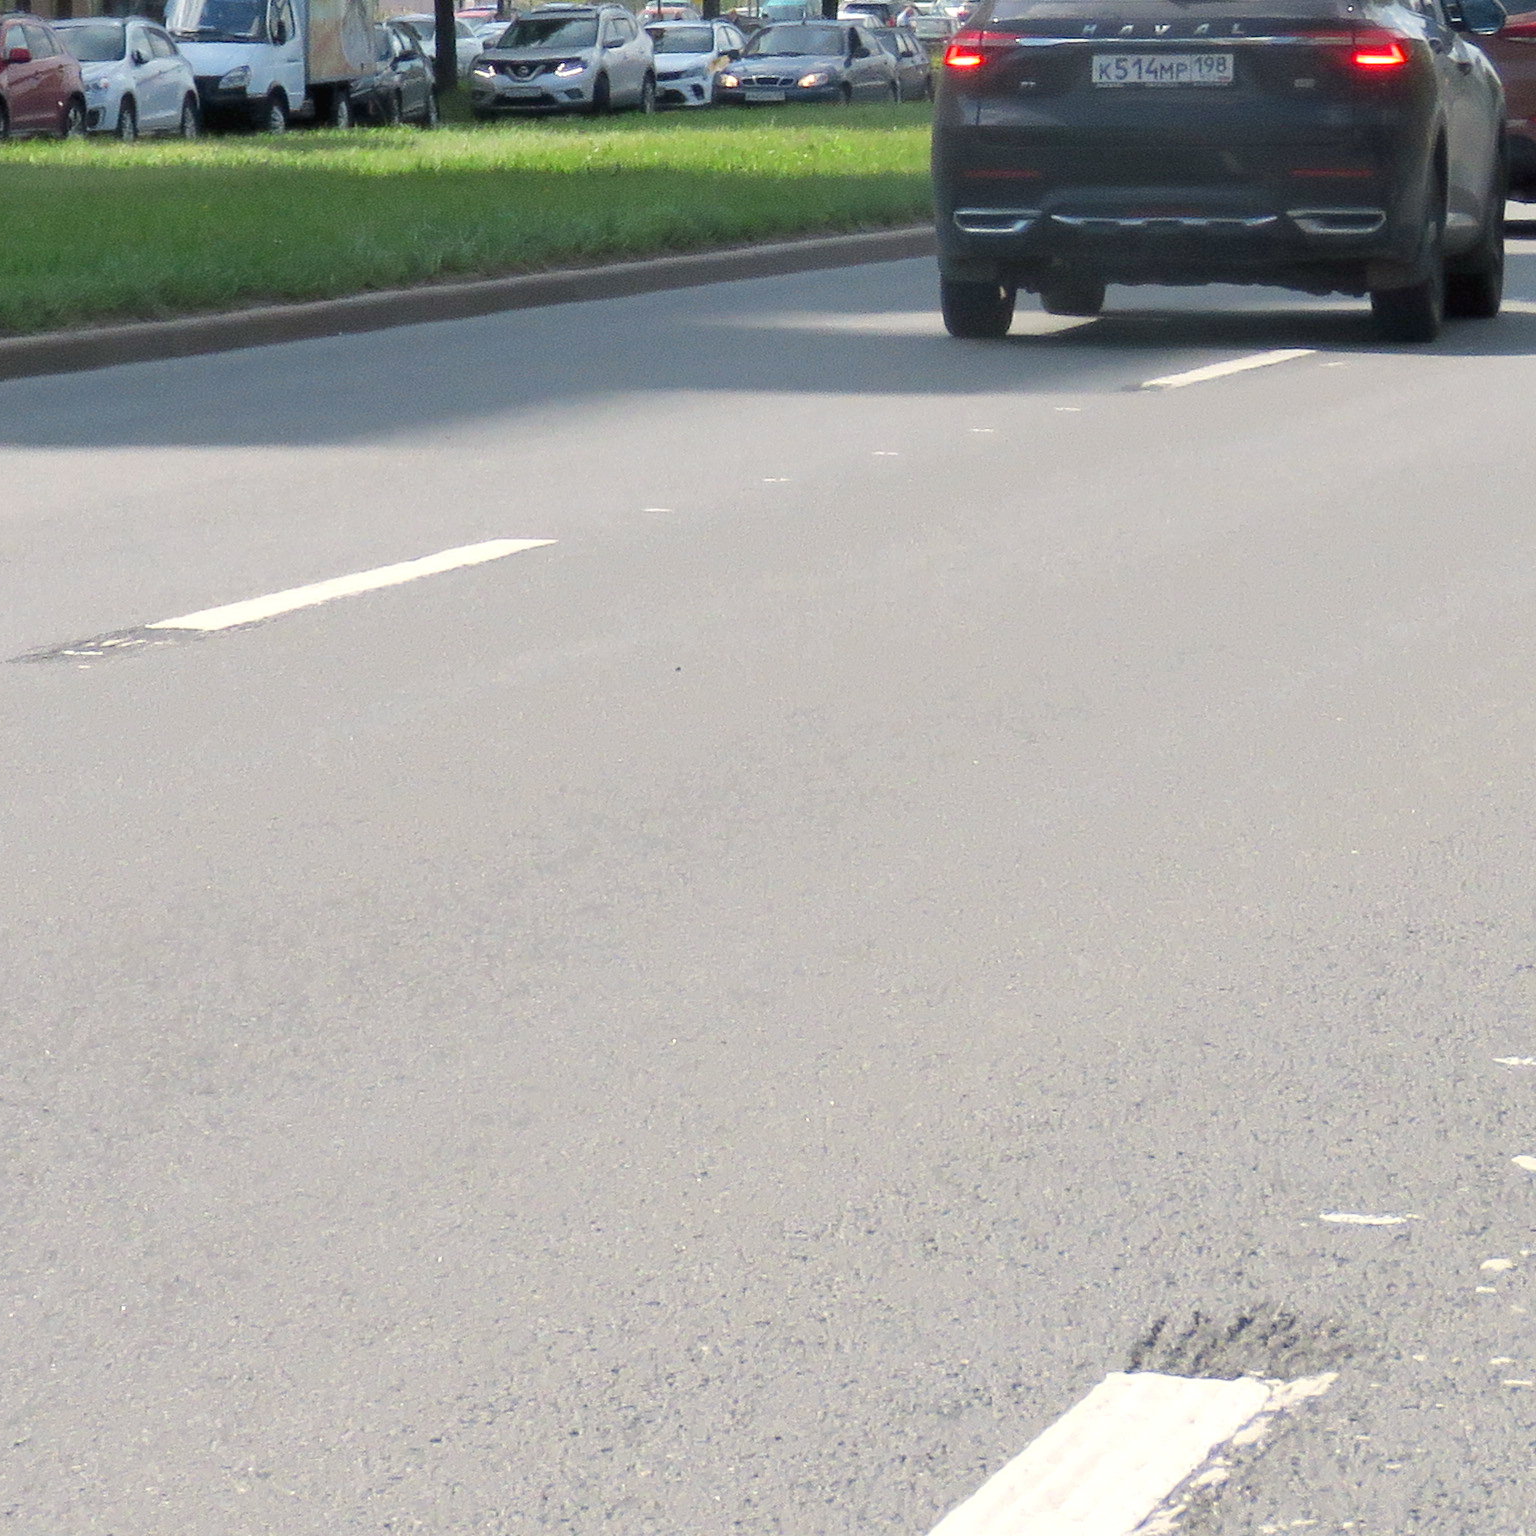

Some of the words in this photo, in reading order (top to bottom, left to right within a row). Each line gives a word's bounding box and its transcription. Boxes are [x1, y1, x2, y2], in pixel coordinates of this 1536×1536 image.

[1081, 23, 1245, 34] HAVAL
[1098, 58, 1189, 80] К514МР
[1194, 56, 1227, 74] 198
